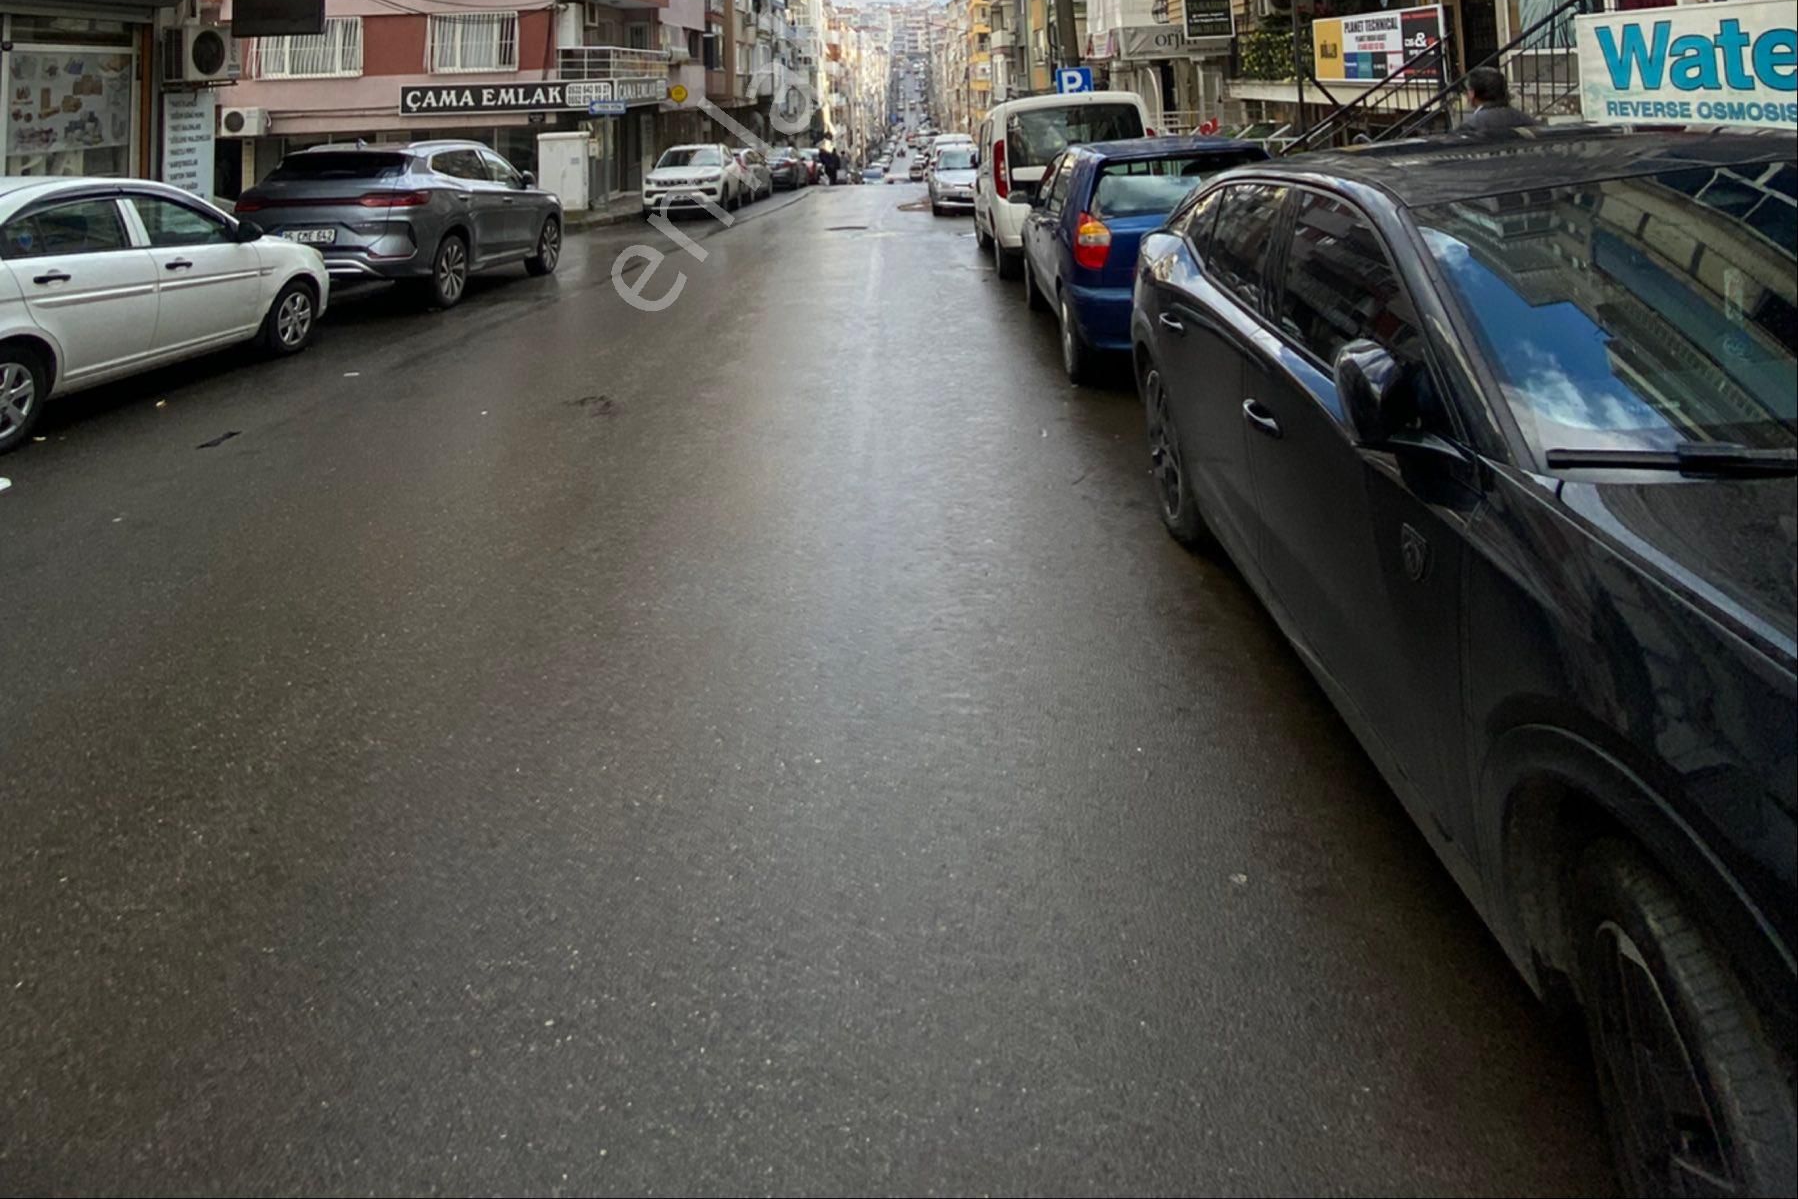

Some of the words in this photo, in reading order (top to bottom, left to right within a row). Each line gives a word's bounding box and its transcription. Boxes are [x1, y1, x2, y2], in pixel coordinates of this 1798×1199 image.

[1061, 71, 1083, 94] P
[406, 90, 475, 112] ÇAMA
[481, 86, 563, 106] EMLAK
[1607, 101, 1692, 119] REVERSE
[1697, 101, 1797, 122] OSMOSIS
